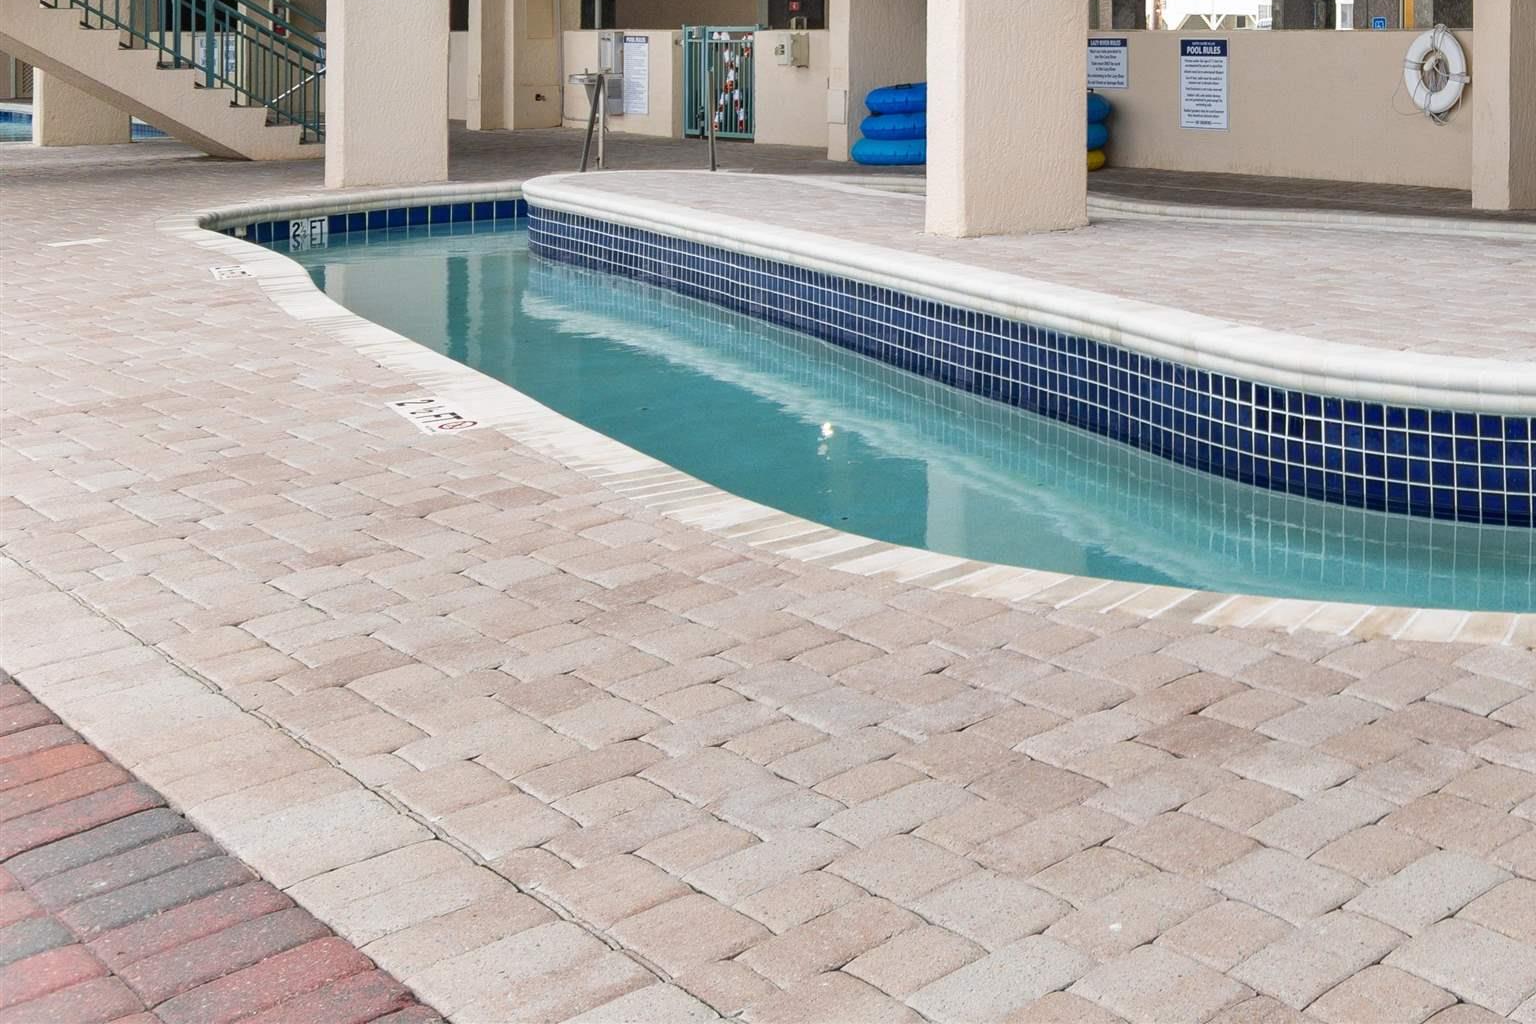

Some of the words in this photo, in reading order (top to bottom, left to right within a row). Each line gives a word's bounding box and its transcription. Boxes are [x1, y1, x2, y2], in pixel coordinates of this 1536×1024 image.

[1187, 46, 1202, 54] POOL
[1203, 46, 1221, 55] RULES
[310, 219, 325, 238] FT
